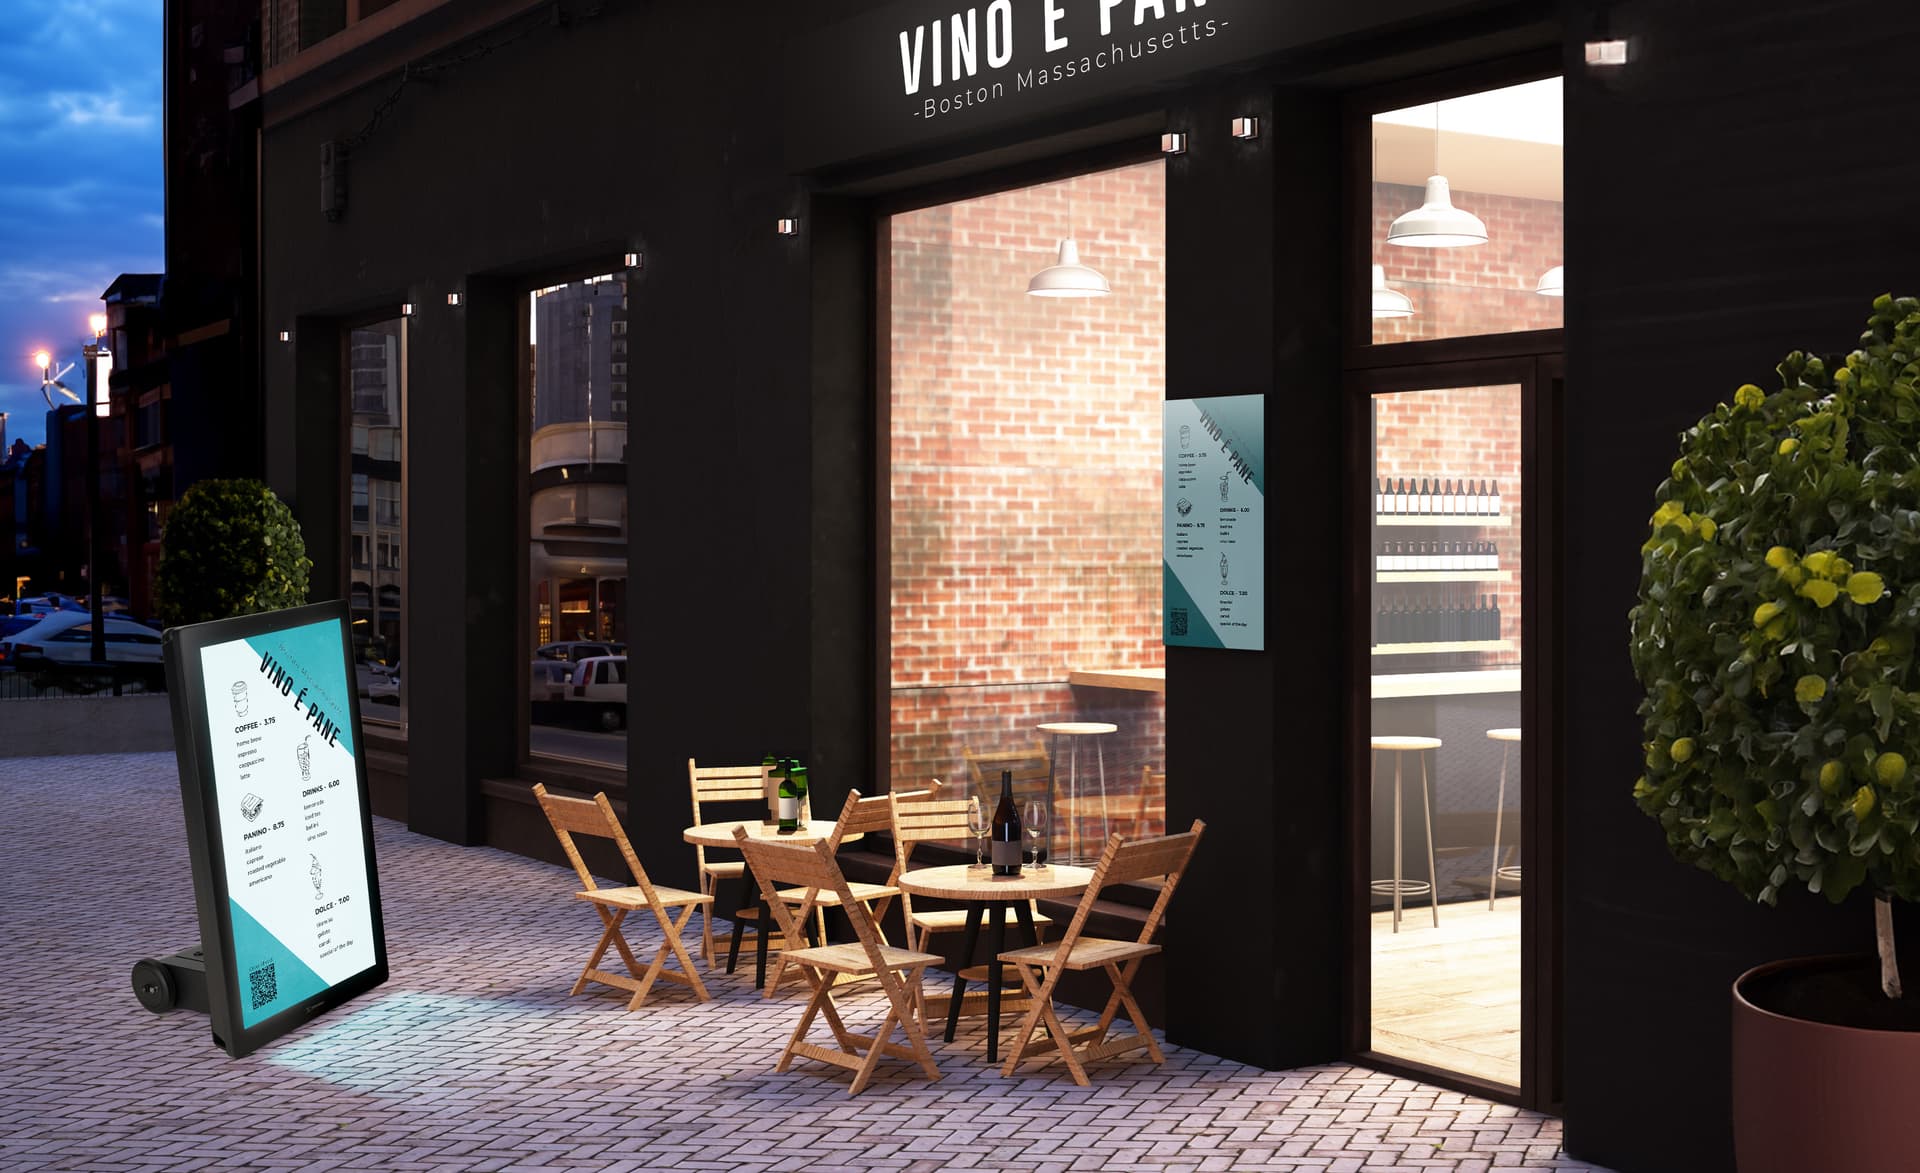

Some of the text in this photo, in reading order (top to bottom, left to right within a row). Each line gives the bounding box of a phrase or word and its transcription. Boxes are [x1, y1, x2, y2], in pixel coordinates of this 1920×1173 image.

[899, 0, 1013, 96] VINO
[913, 19, 1229, 119] -Boston Massachusetts-
[1200, 409, 1223, 442] VINO
[1229, 450, 1255, 485] PANE
[259, 651, 294, 697] VINO
[293, 687, 309, 711] É
[305, 702, 341, 748] PANE
[234, 721, 259, 734] COFFEE
[264, 716, 276, 726] 3.75
[302, 785, 323, 798] DRINKS
[328, 779, 340, 789] 6.00
[243, 827, 267, 841] PANINO
[315, 902, 334, 916] DOLCE
[338, 895, 350, 905] 7.00
